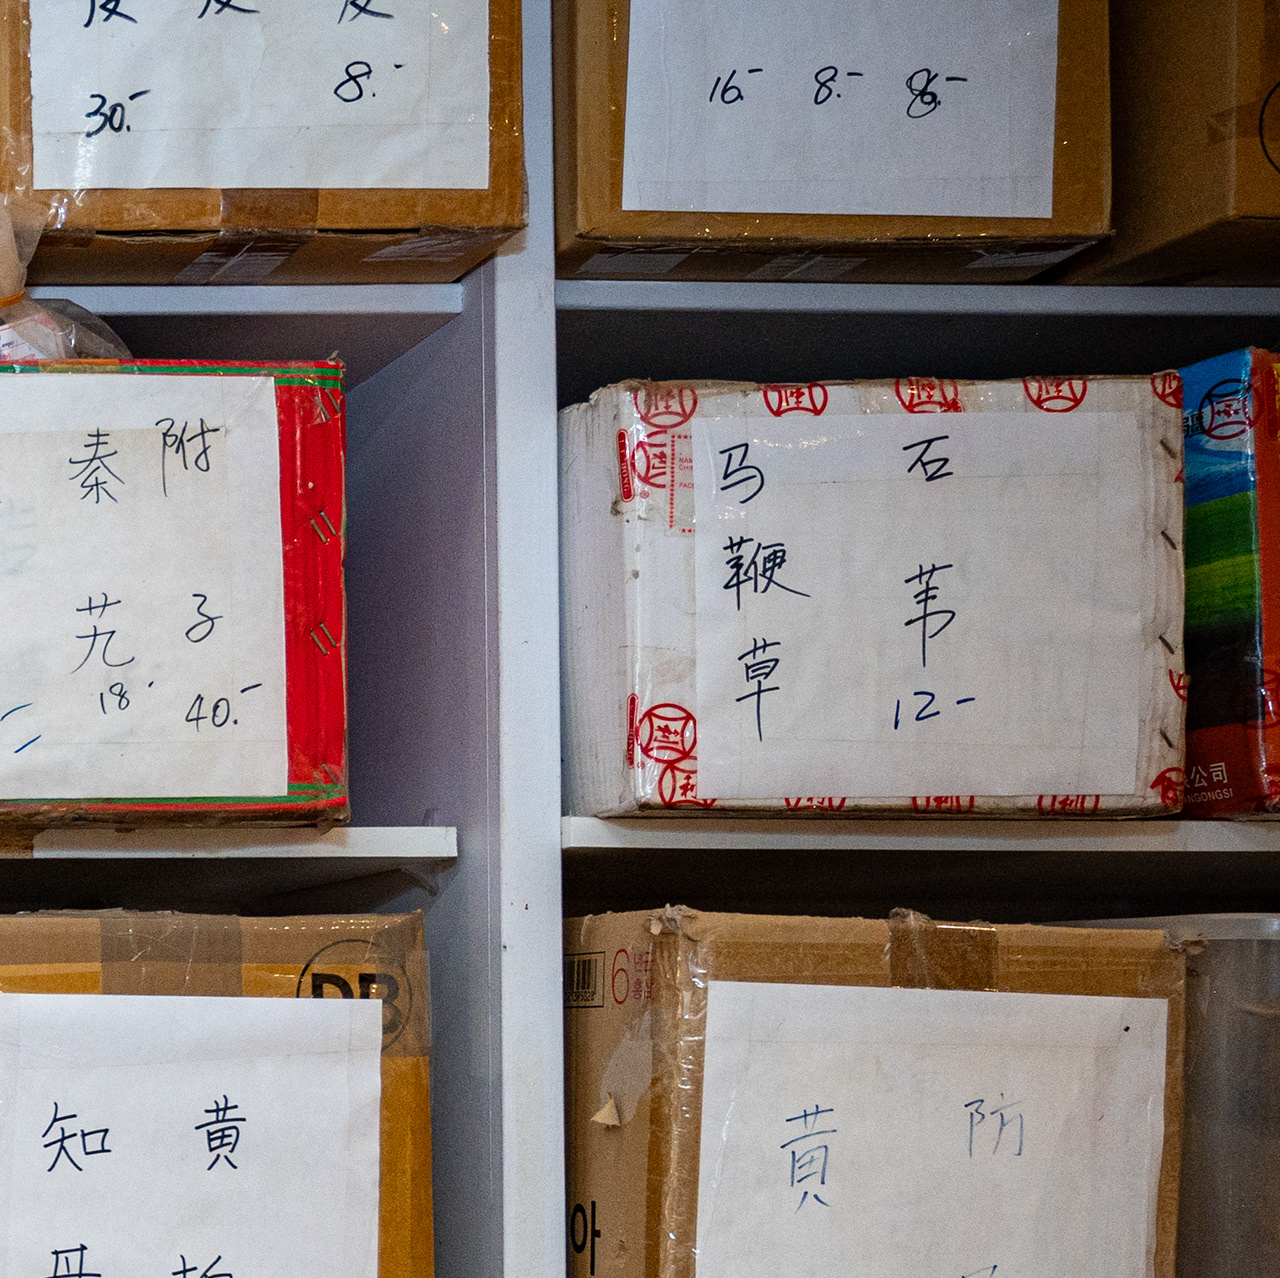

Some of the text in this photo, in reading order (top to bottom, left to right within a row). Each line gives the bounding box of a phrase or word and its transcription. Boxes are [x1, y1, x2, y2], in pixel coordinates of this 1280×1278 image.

[154, 416, 223, 644] 附子
[717, 441, 811, 742] 马鞭草
